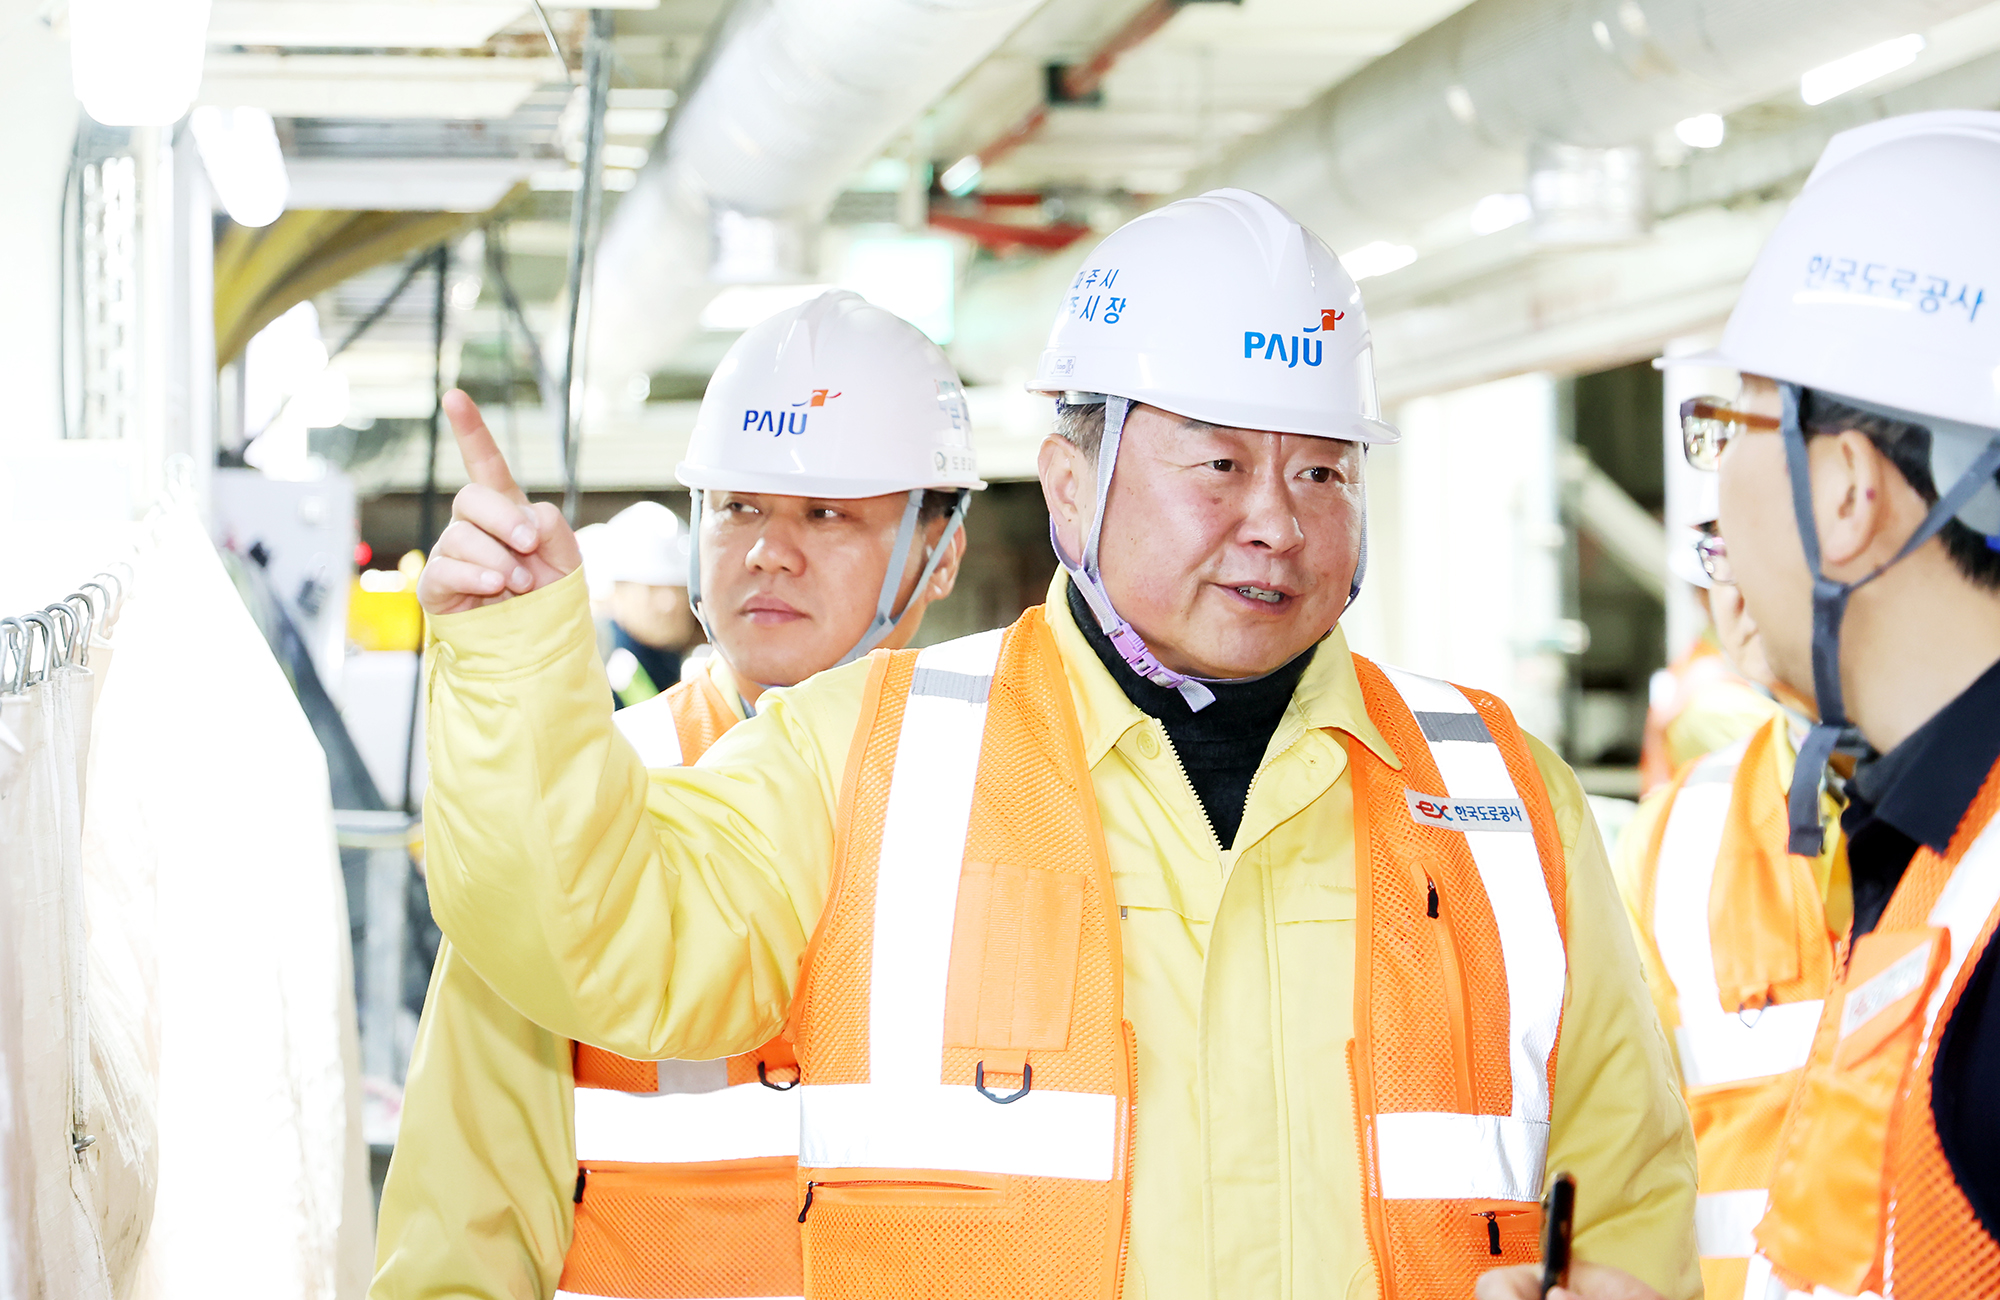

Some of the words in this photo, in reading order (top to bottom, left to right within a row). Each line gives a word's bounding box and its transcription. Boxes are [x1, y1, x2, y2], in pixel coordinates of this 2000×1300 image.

[1804, 253, 1985, 323] 한국도로공사
[1244, 331, 1323, 368] PAJU
[743, 409, 808, 437] PAJU
[1454, 805, 1523, 823] 한국도로공사
